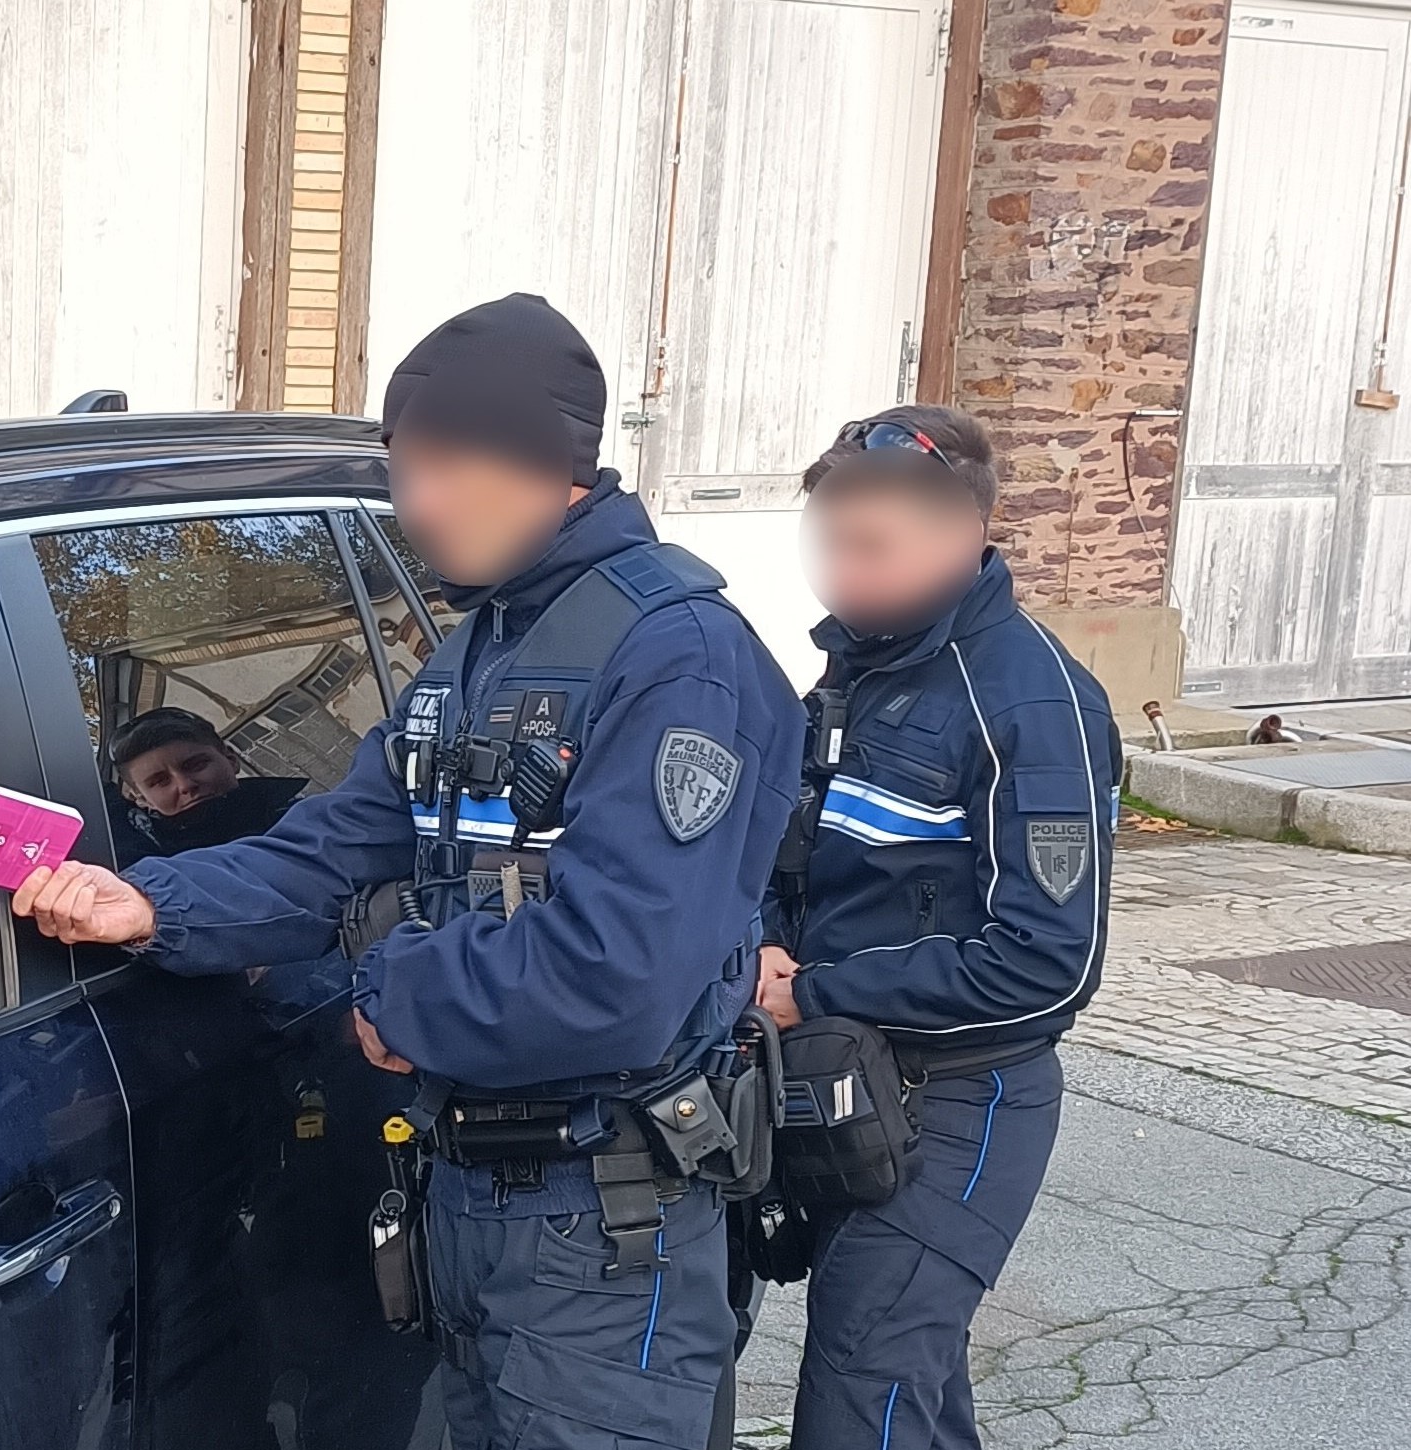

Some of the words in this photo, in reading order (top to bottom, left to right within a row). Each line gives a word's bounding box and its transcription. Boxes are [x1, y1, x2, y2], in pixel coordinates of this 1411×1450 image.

[536, 696, 550, 715] A
[669, 738, 735, 776] POLICE
[1031, 824, 1087, 835] POLICE
